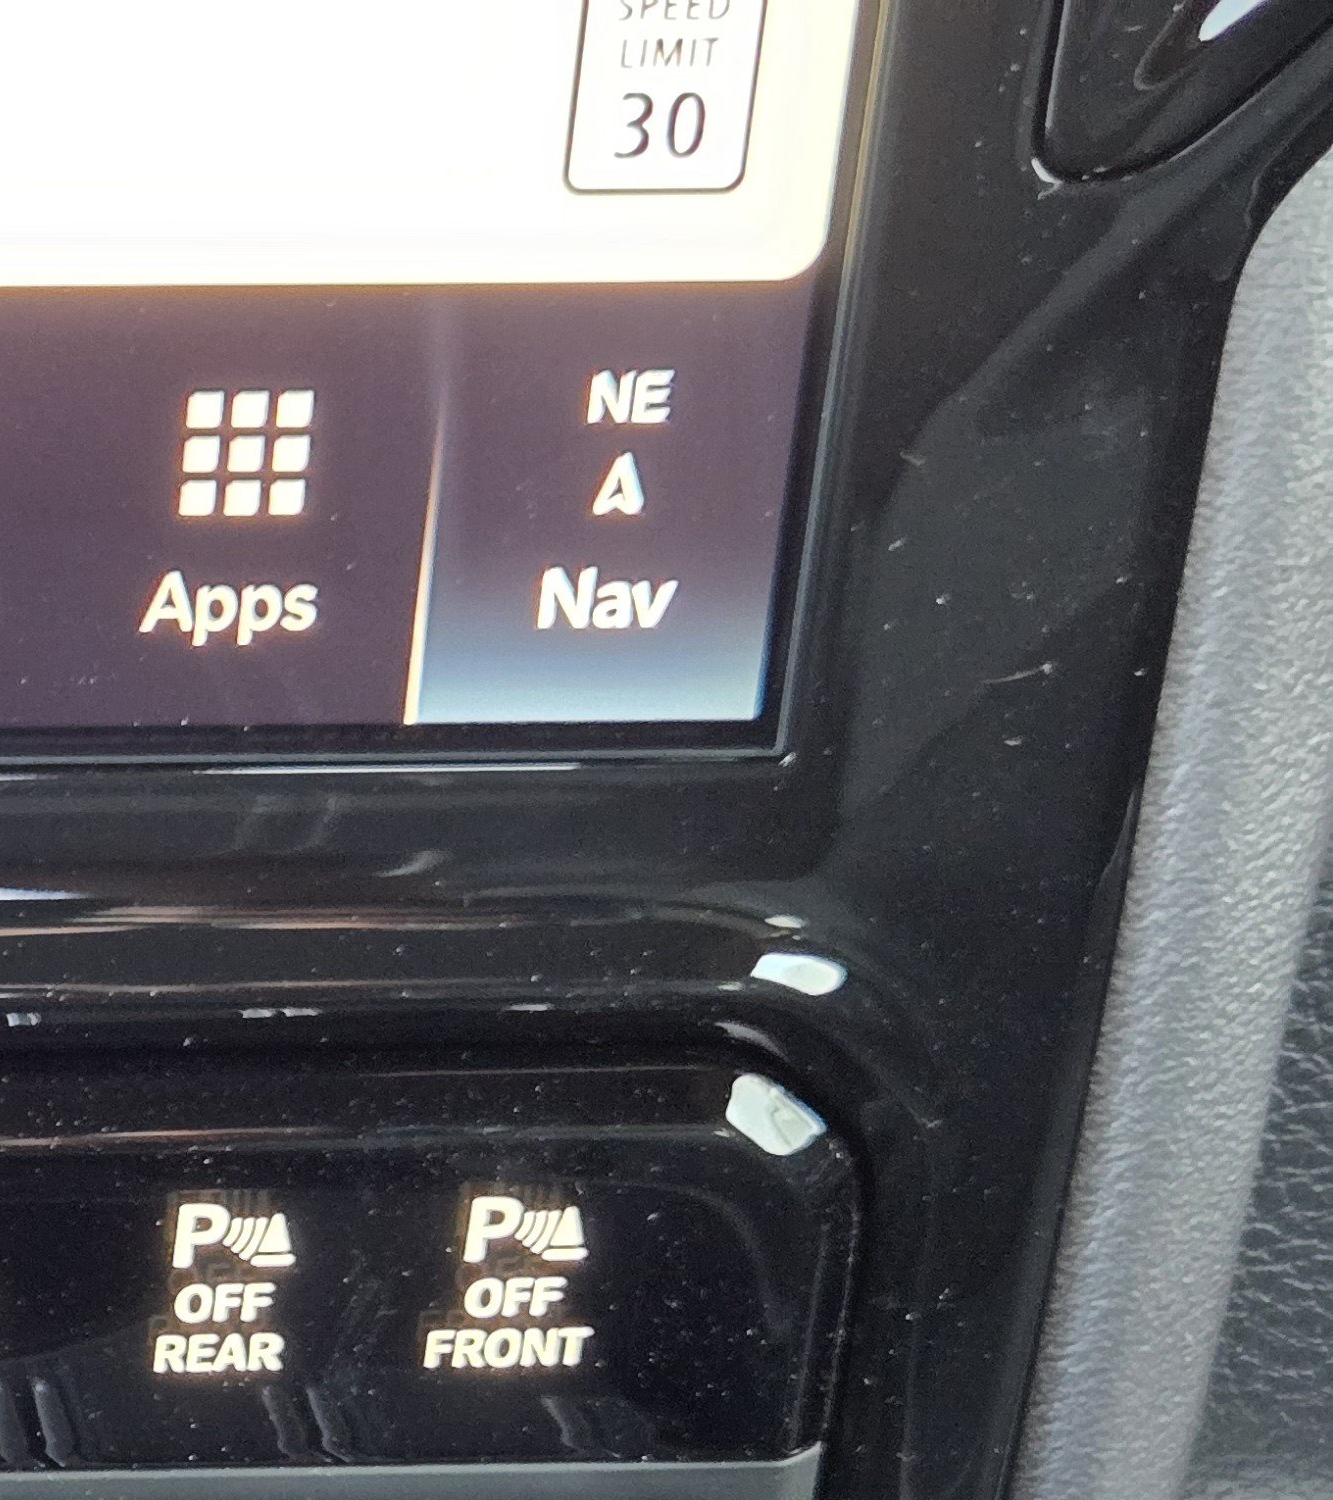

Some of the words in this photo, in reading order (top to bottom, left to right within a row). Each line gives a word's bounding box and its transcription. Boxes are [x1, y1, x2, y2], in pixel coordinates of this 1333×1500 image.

[620, 37, 719, 68] LIMIT
[614, 92, 706, 158] 30
[587, 369, 675, 425] NE
[138, 570, 318, 647] Apps
[536, 566, 679, 630] Nav
[173, 1282, 276, 1324] OFF
[463, 1276, 568, 1319] OFF
[153, 1332, 285, 1374] REAR
[423, 1326, 594, 1369] FRONT
